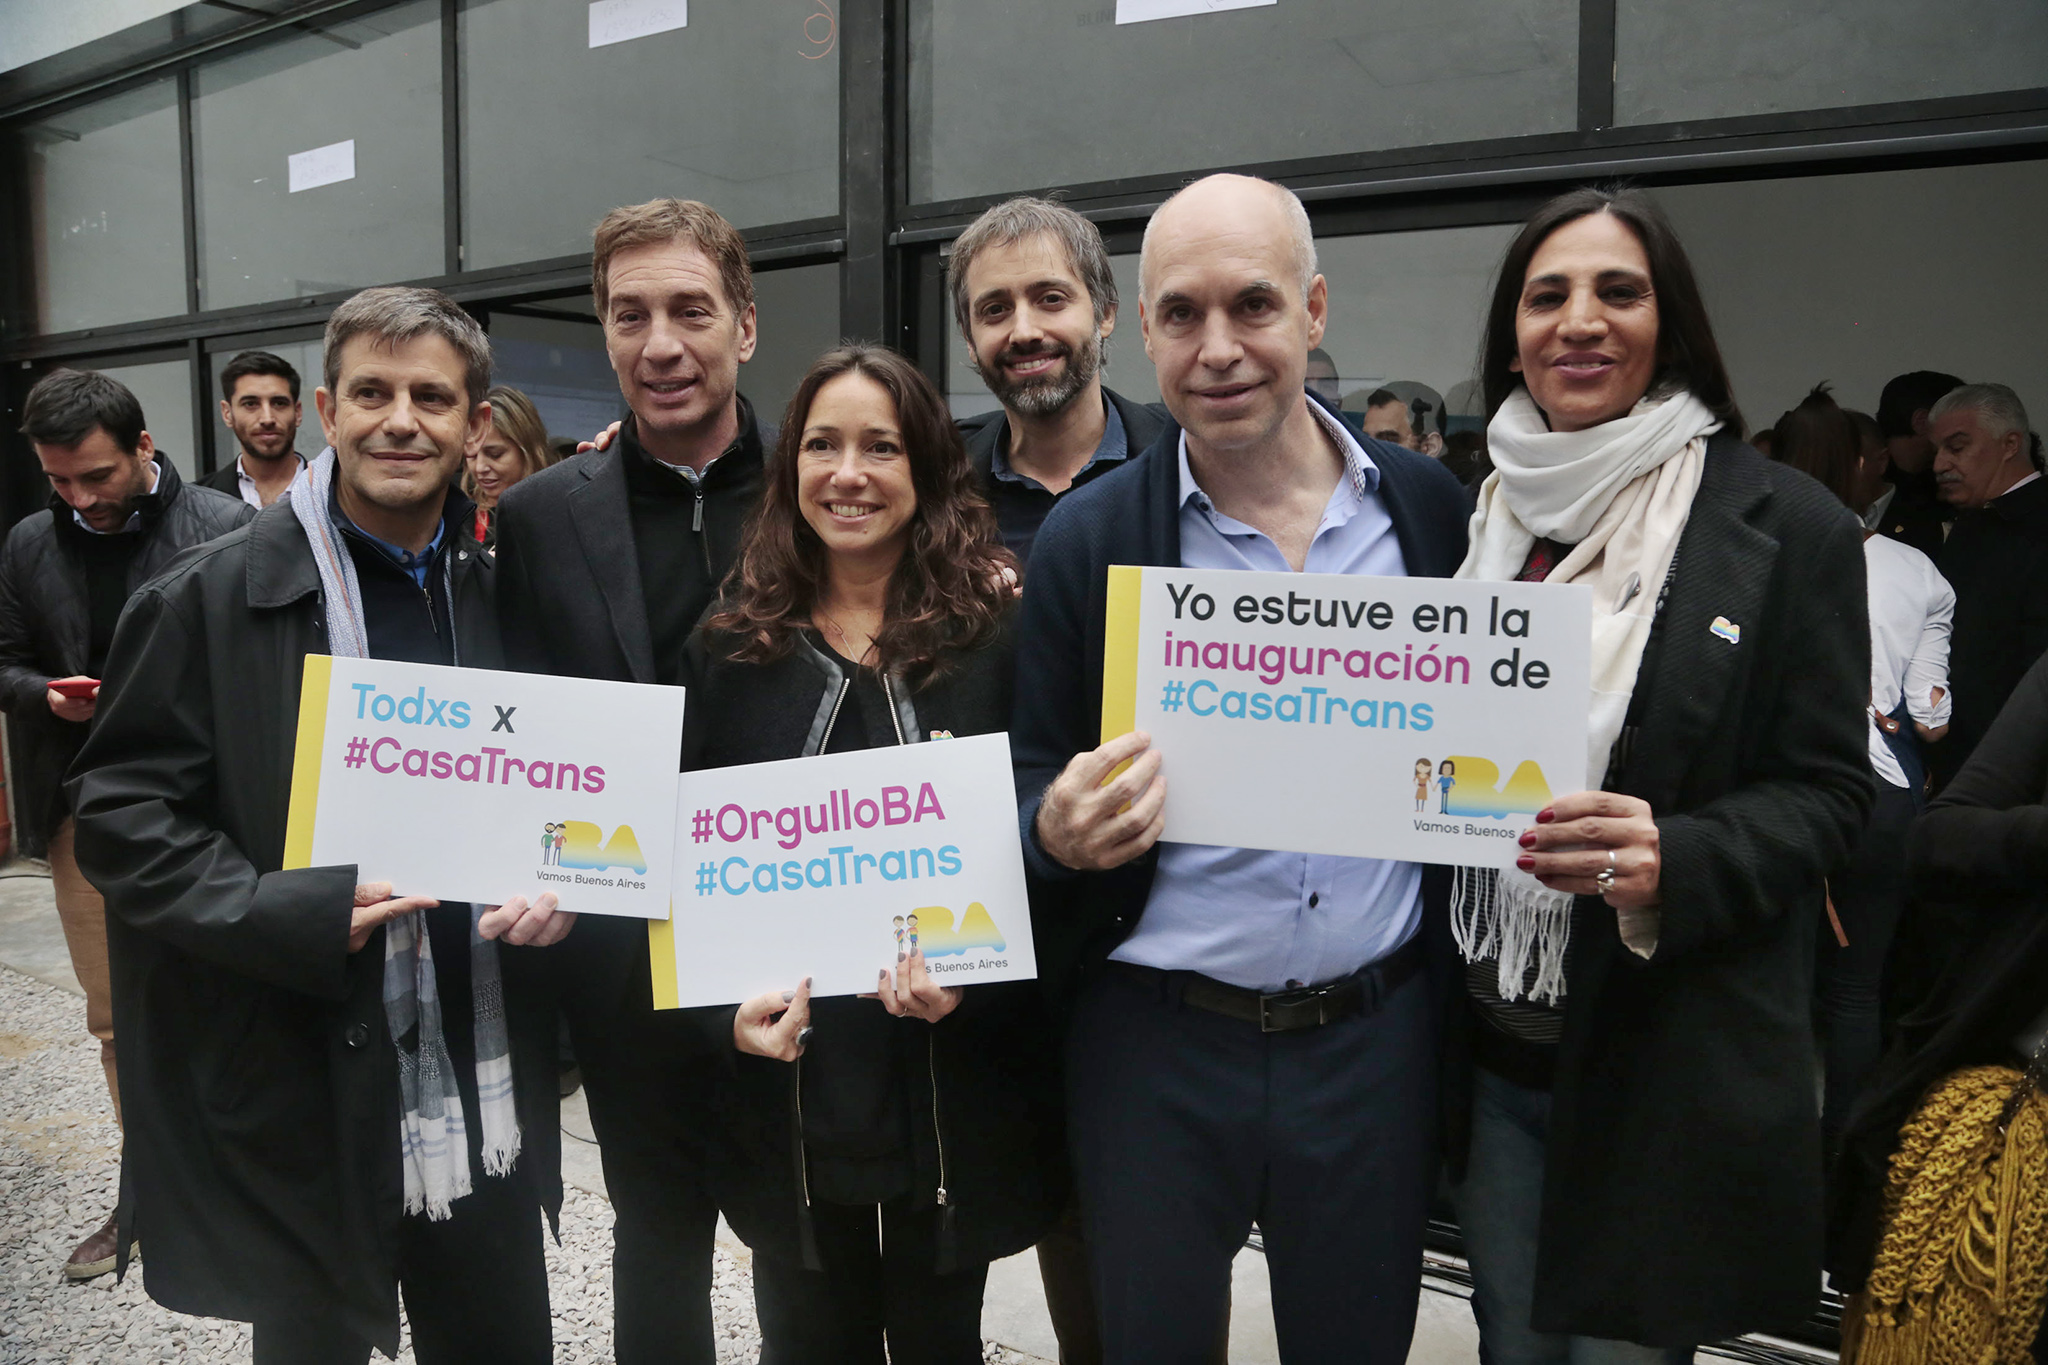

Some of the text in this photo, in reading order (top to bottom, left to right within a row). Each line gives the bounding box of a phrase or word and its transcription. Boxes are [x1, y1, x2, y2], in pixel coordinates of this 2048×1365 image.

[1166, 583, 1530, 638] Yo estuve en la
[1165, 631, 1550, 689] inauguración de
[352, 683, 517, 733] Todxs x
[1160, 679, 1434, 732] #CasaTrans
[344, 736, 605, 794] #CasaTrans
[691, 782, 946, 850] #OrgulloBA
[1413, 819, 1460, 834] Vamos
[1464, 823, 1516, 839] Buenos
[537, 870, 646, 890] Vamos Buenos Aires
[695, 845, 962, 896] #CasaTrans
[935, 962, 975, 973] Buenos
[978, 959, 1009, 970] Aires
